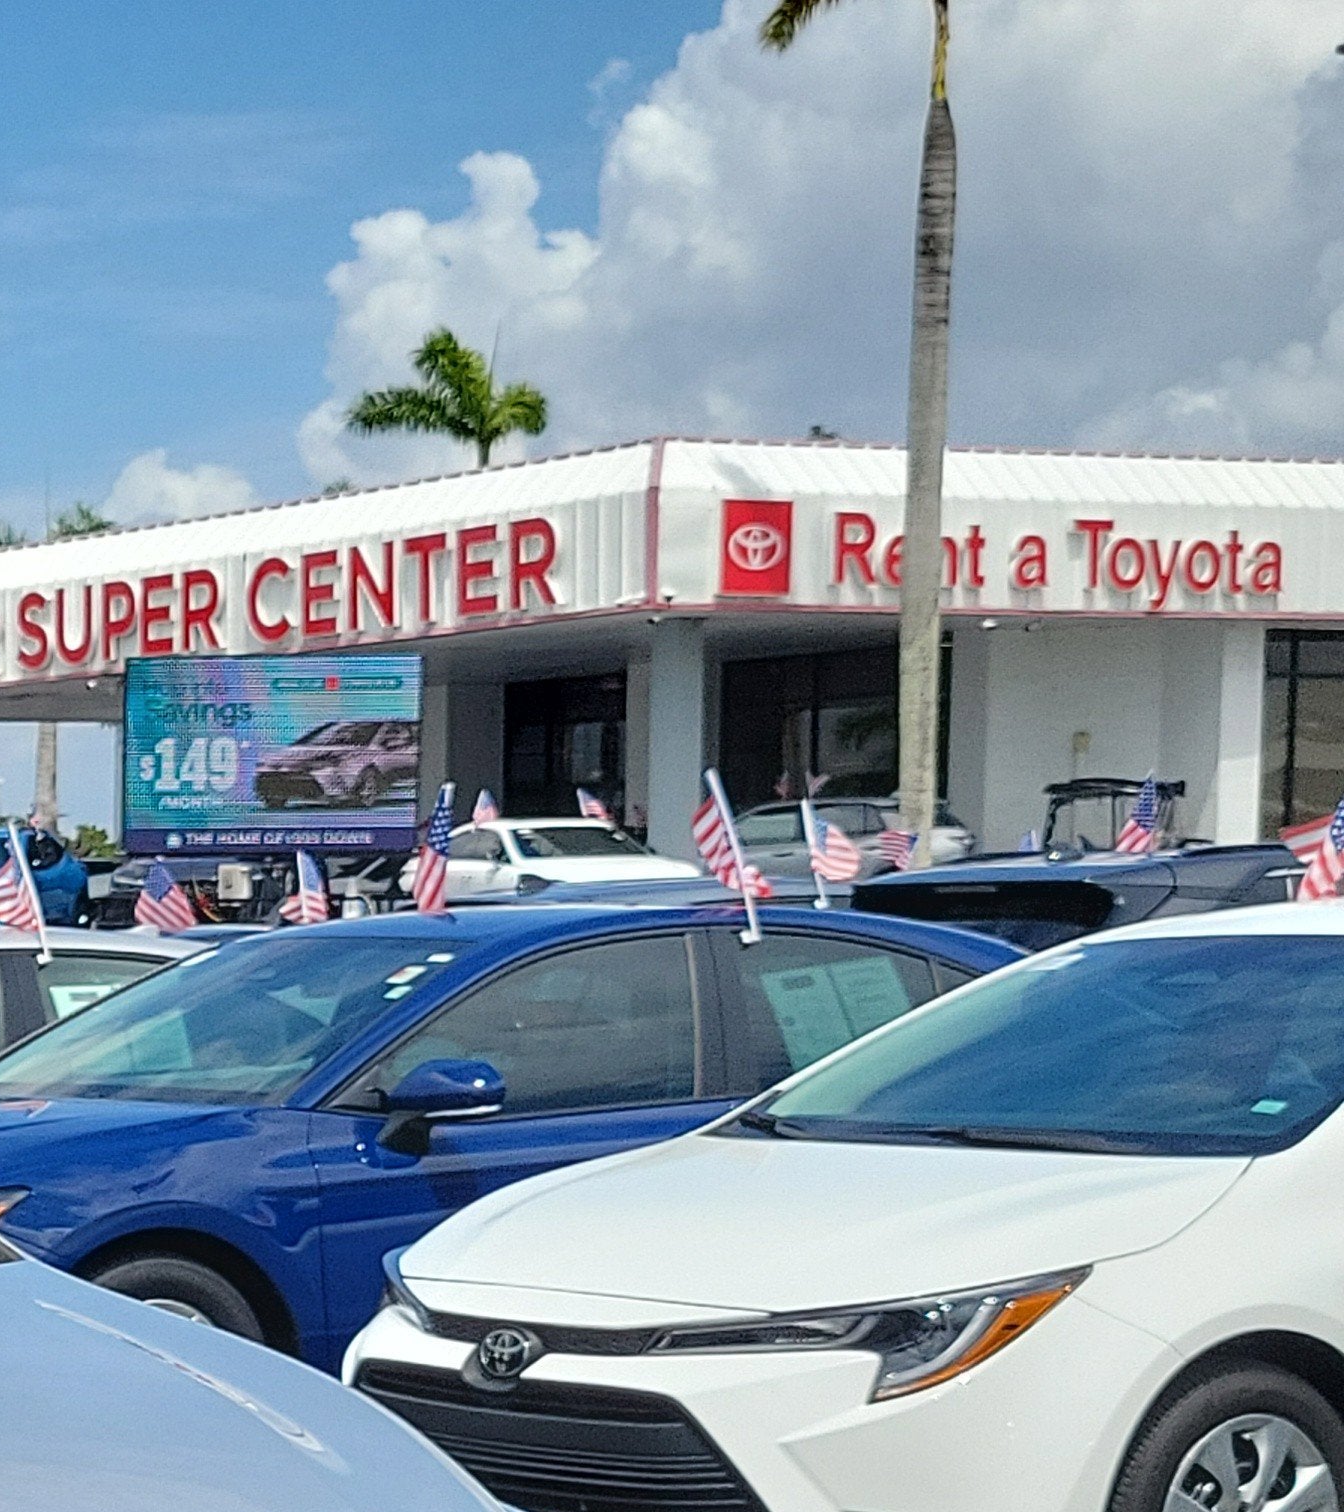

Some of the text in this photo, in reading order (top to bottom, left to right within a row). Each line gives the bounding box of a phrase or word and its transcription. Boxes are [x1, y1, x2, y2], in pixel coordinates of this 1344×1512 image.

[17, 569, 222, 669] SUPER
[248, 517, 557, 642] CENTER
[833, 512, 1282, 608] Rent a Toyota
